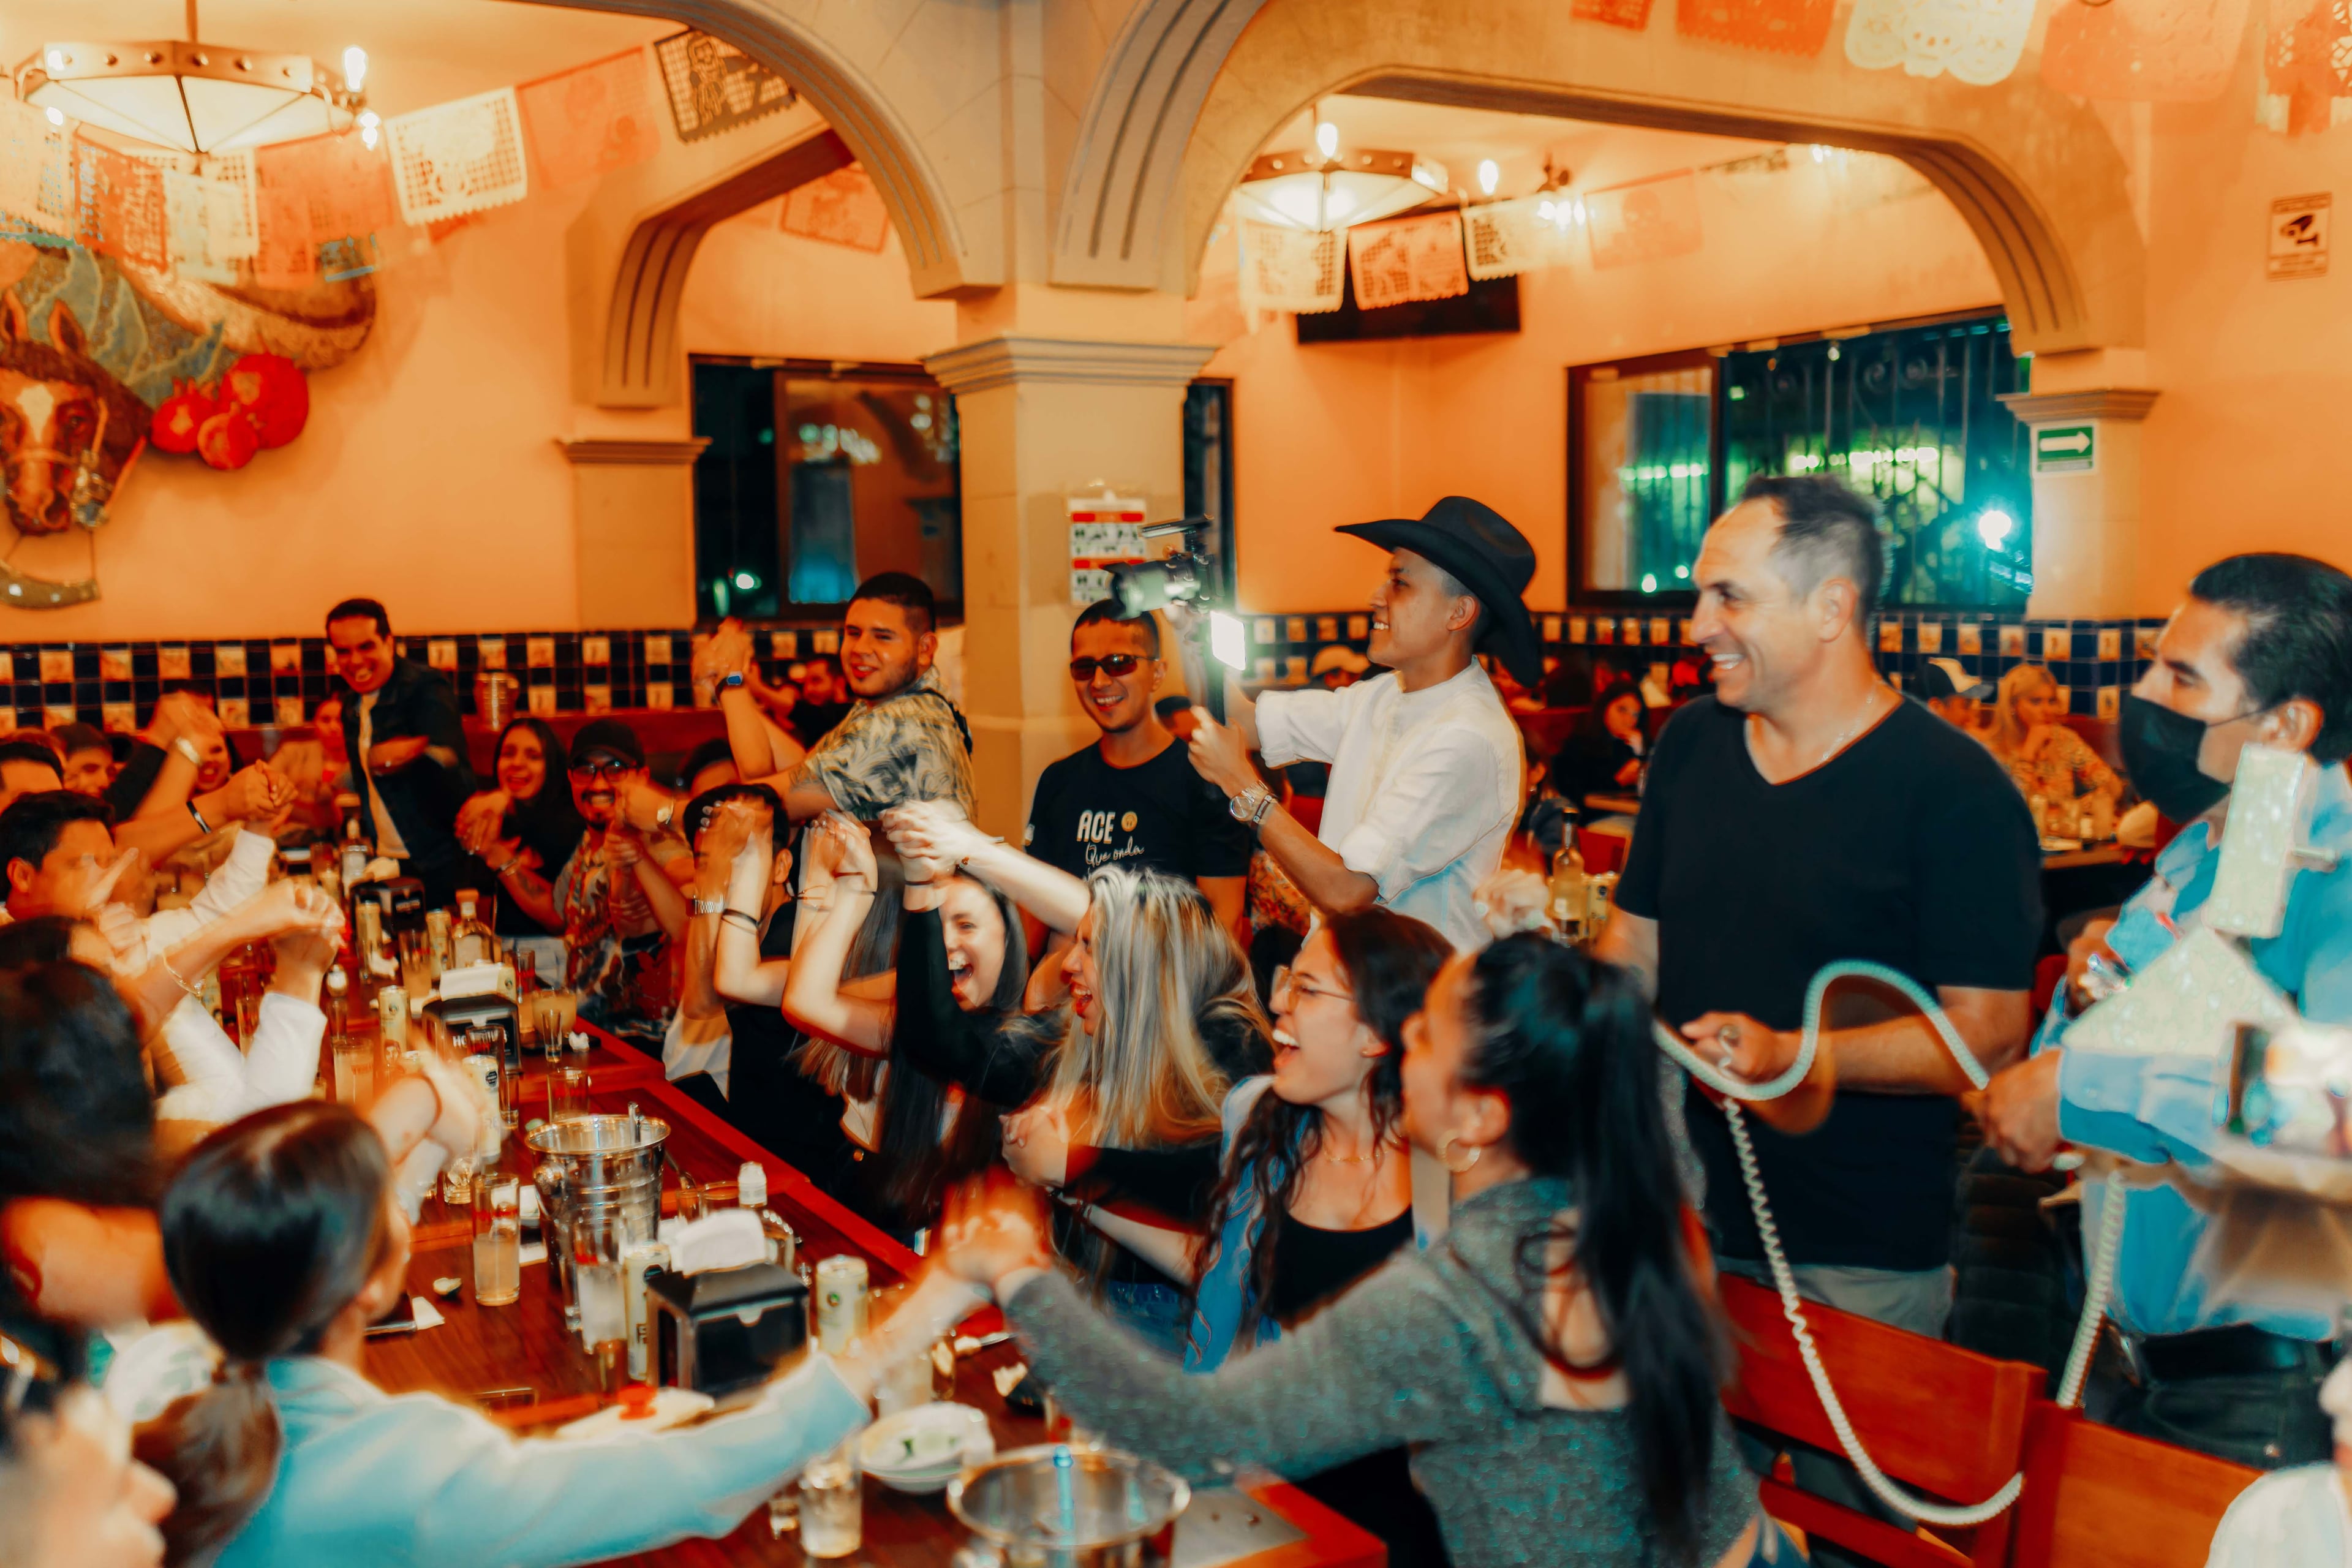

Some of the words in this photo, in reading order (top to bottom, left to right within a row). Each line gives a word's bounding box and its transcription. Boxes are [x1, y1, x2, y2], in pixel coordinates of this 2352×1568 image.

[1077, 809, 1115, 844] ACE
[1085, 842, 1112, 868] Que
[1113, 836, 1145, 861] onda
